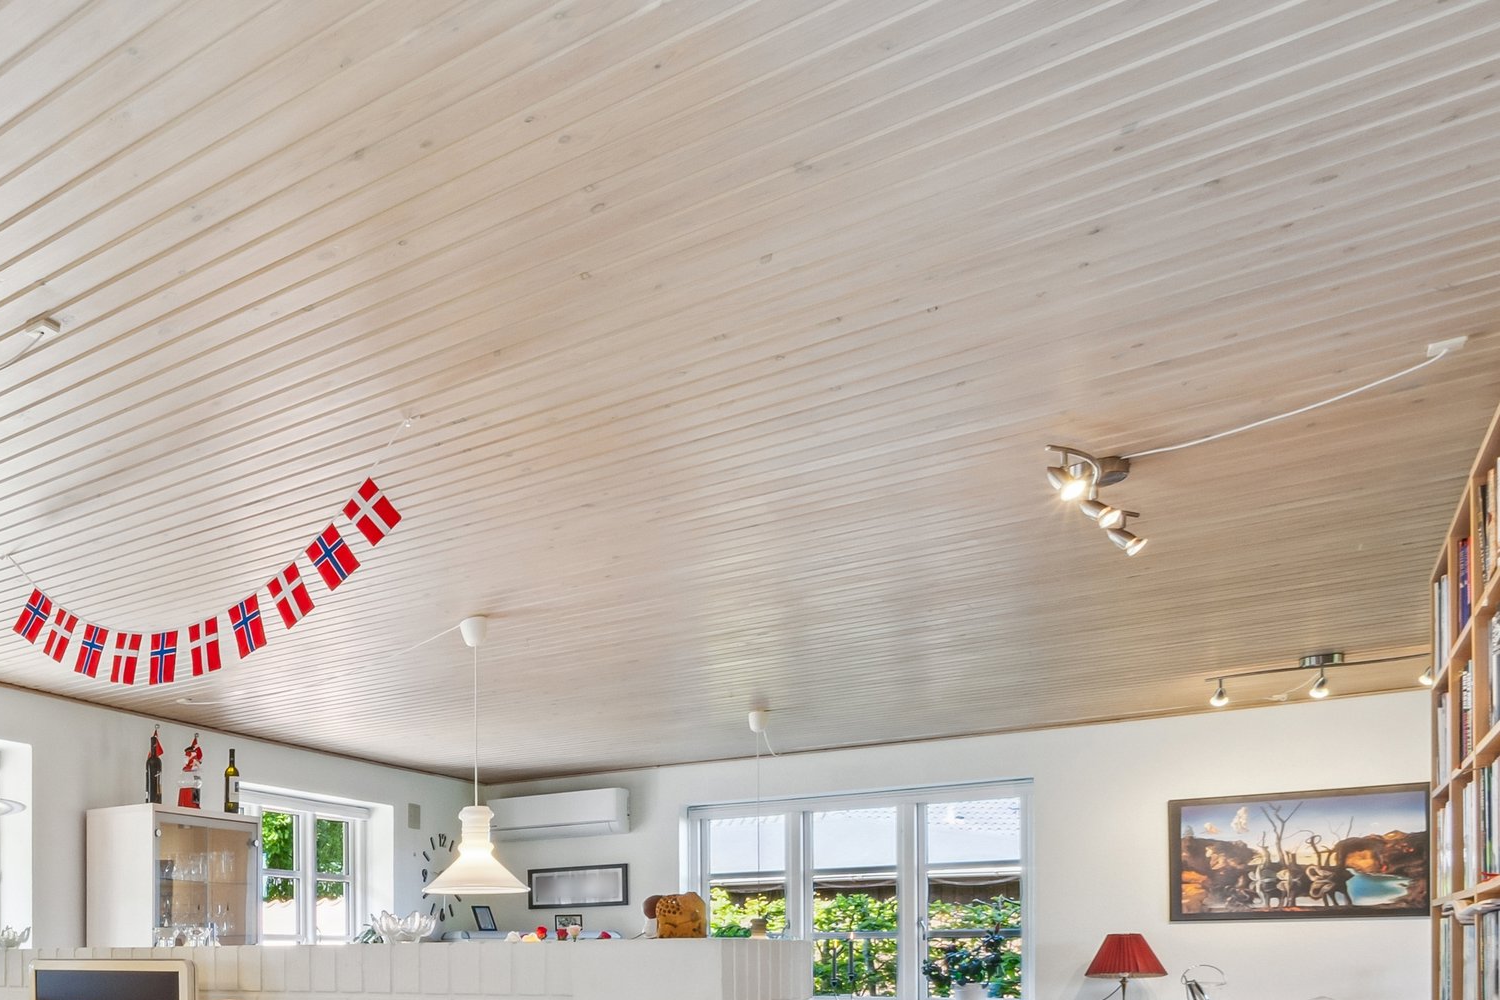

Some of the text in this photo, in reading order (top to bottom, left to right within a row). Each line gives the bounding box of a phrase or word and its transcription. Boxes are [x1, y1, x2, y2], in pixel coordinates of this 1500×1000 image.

[439, 833, 446, 848] 12
[422, 869, 428, 882] 9
[440, 908, 445, 922] 6
